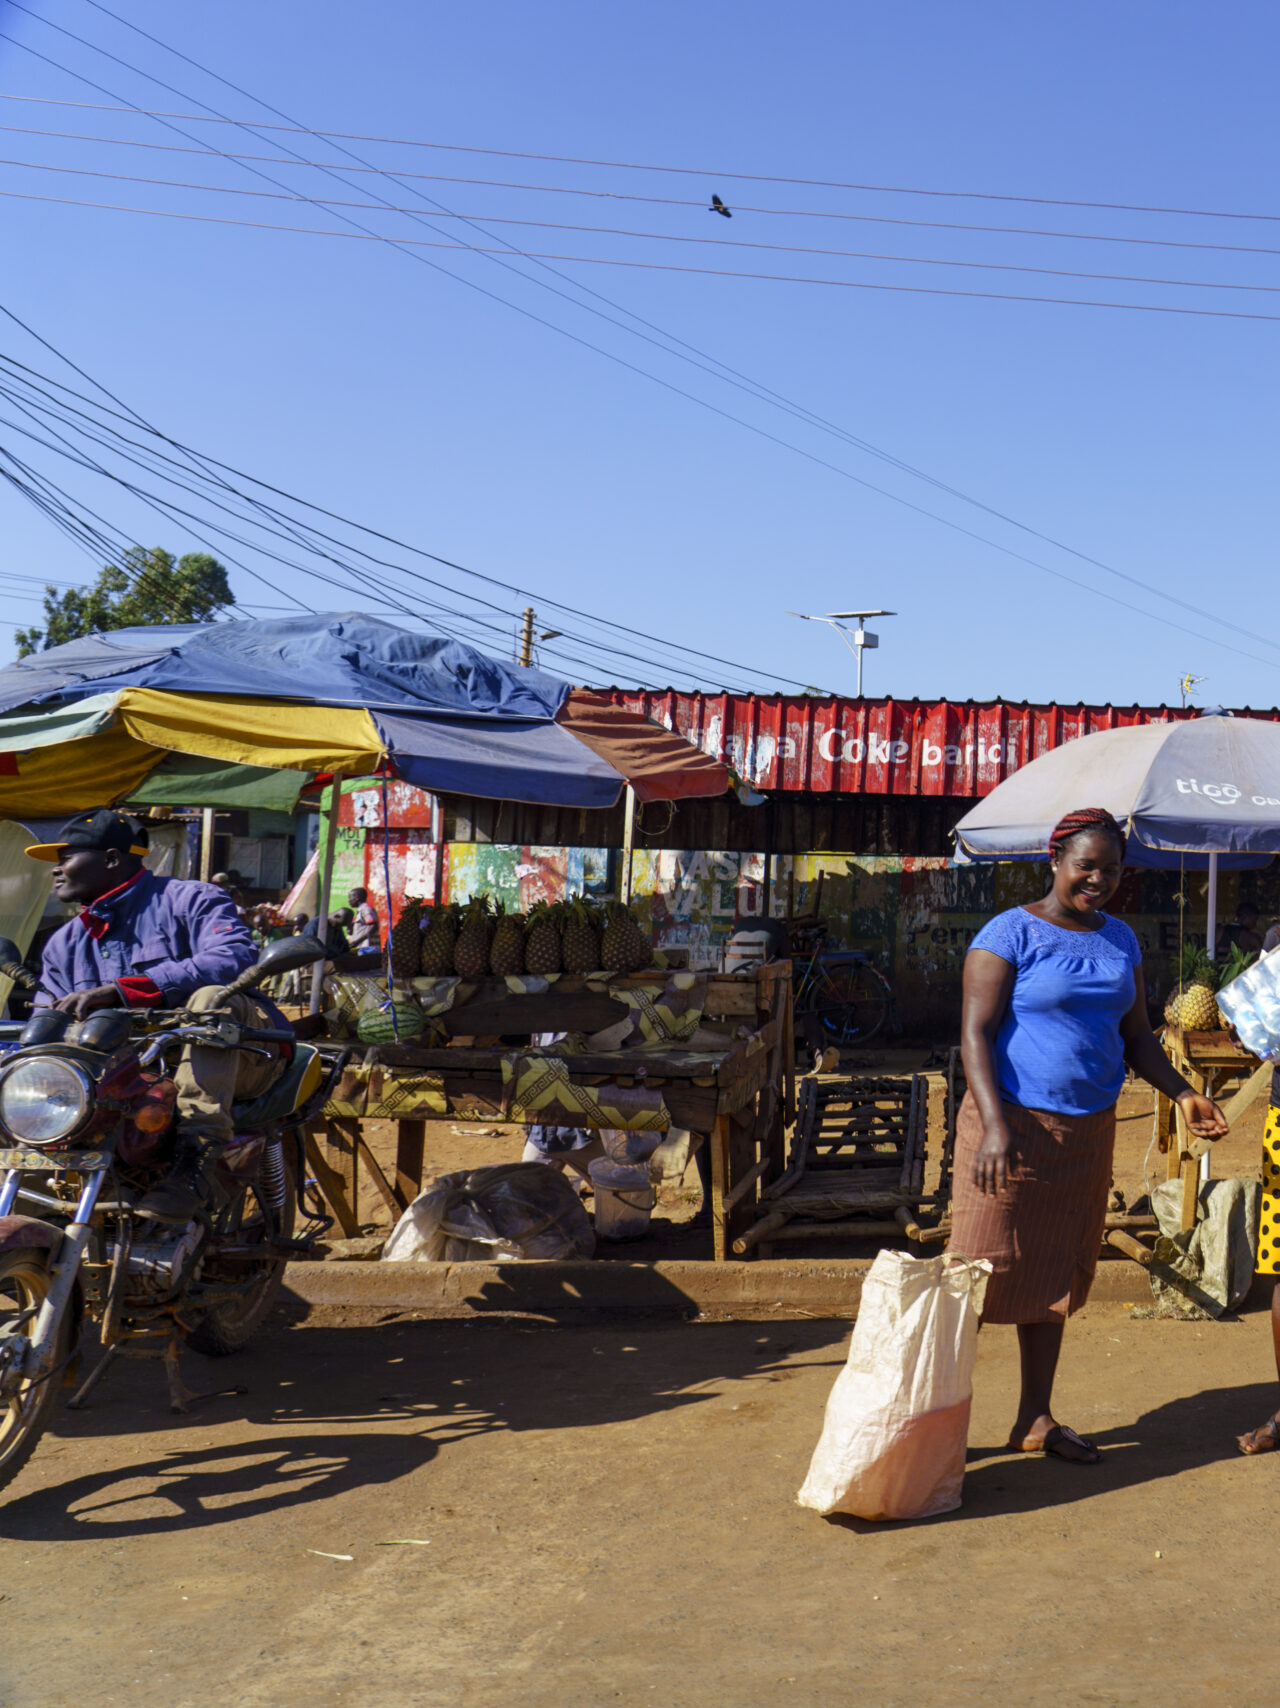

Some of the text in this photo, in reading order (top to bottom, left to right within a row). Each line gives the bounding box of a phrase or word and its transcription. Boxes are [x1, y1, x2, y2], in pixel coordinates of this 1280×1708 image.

[819, 728, 909, 764] Coke
[922, 737, 1016, 766] baridi
[1176, 778, 1241, 805] tigo
